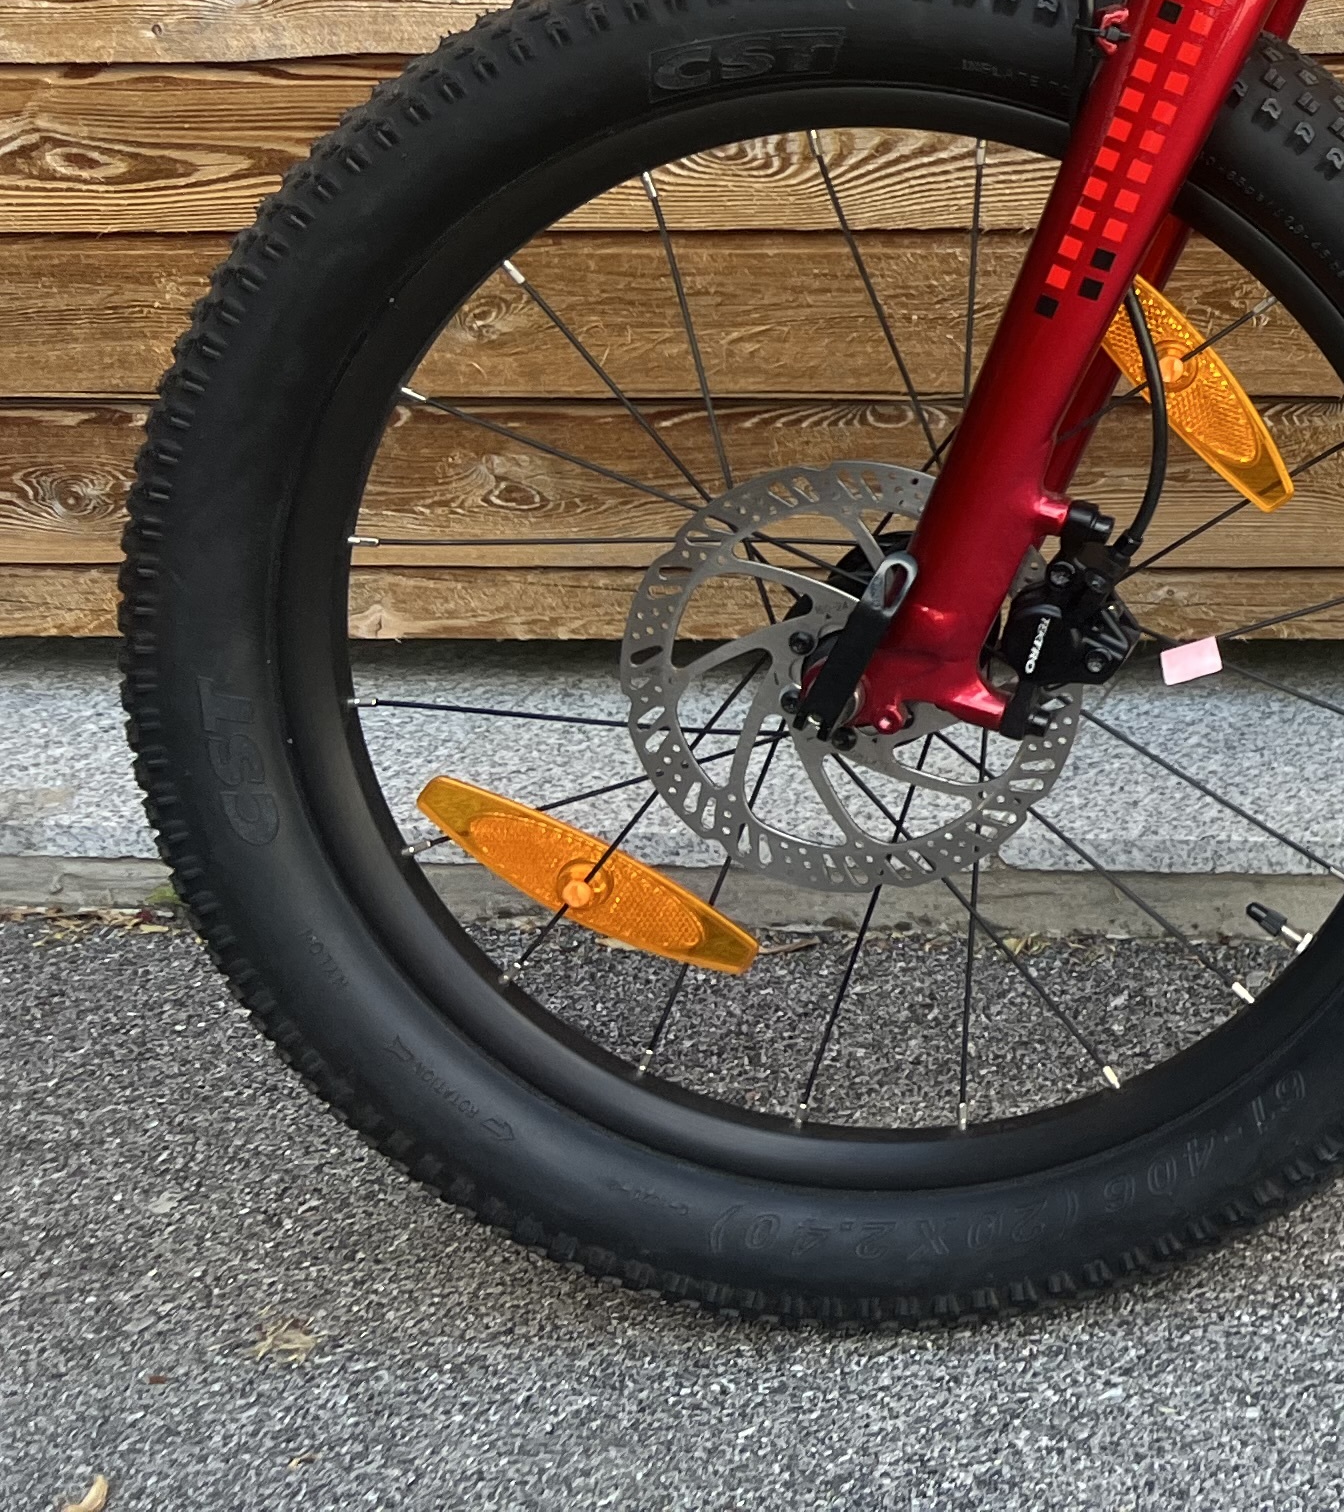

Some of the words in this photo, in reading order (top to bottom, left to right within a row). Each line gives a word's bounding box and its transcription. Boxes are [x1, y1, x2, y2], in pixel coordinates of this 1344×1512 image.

[652, 34, 840, 92] CST
[1025, 617, 1051, 674] TEKTRO
[197, 671, 288, 852] CST
[298, 926, 351, 991] NYLON
[408, 1059, 481, 1120] ROTATION
